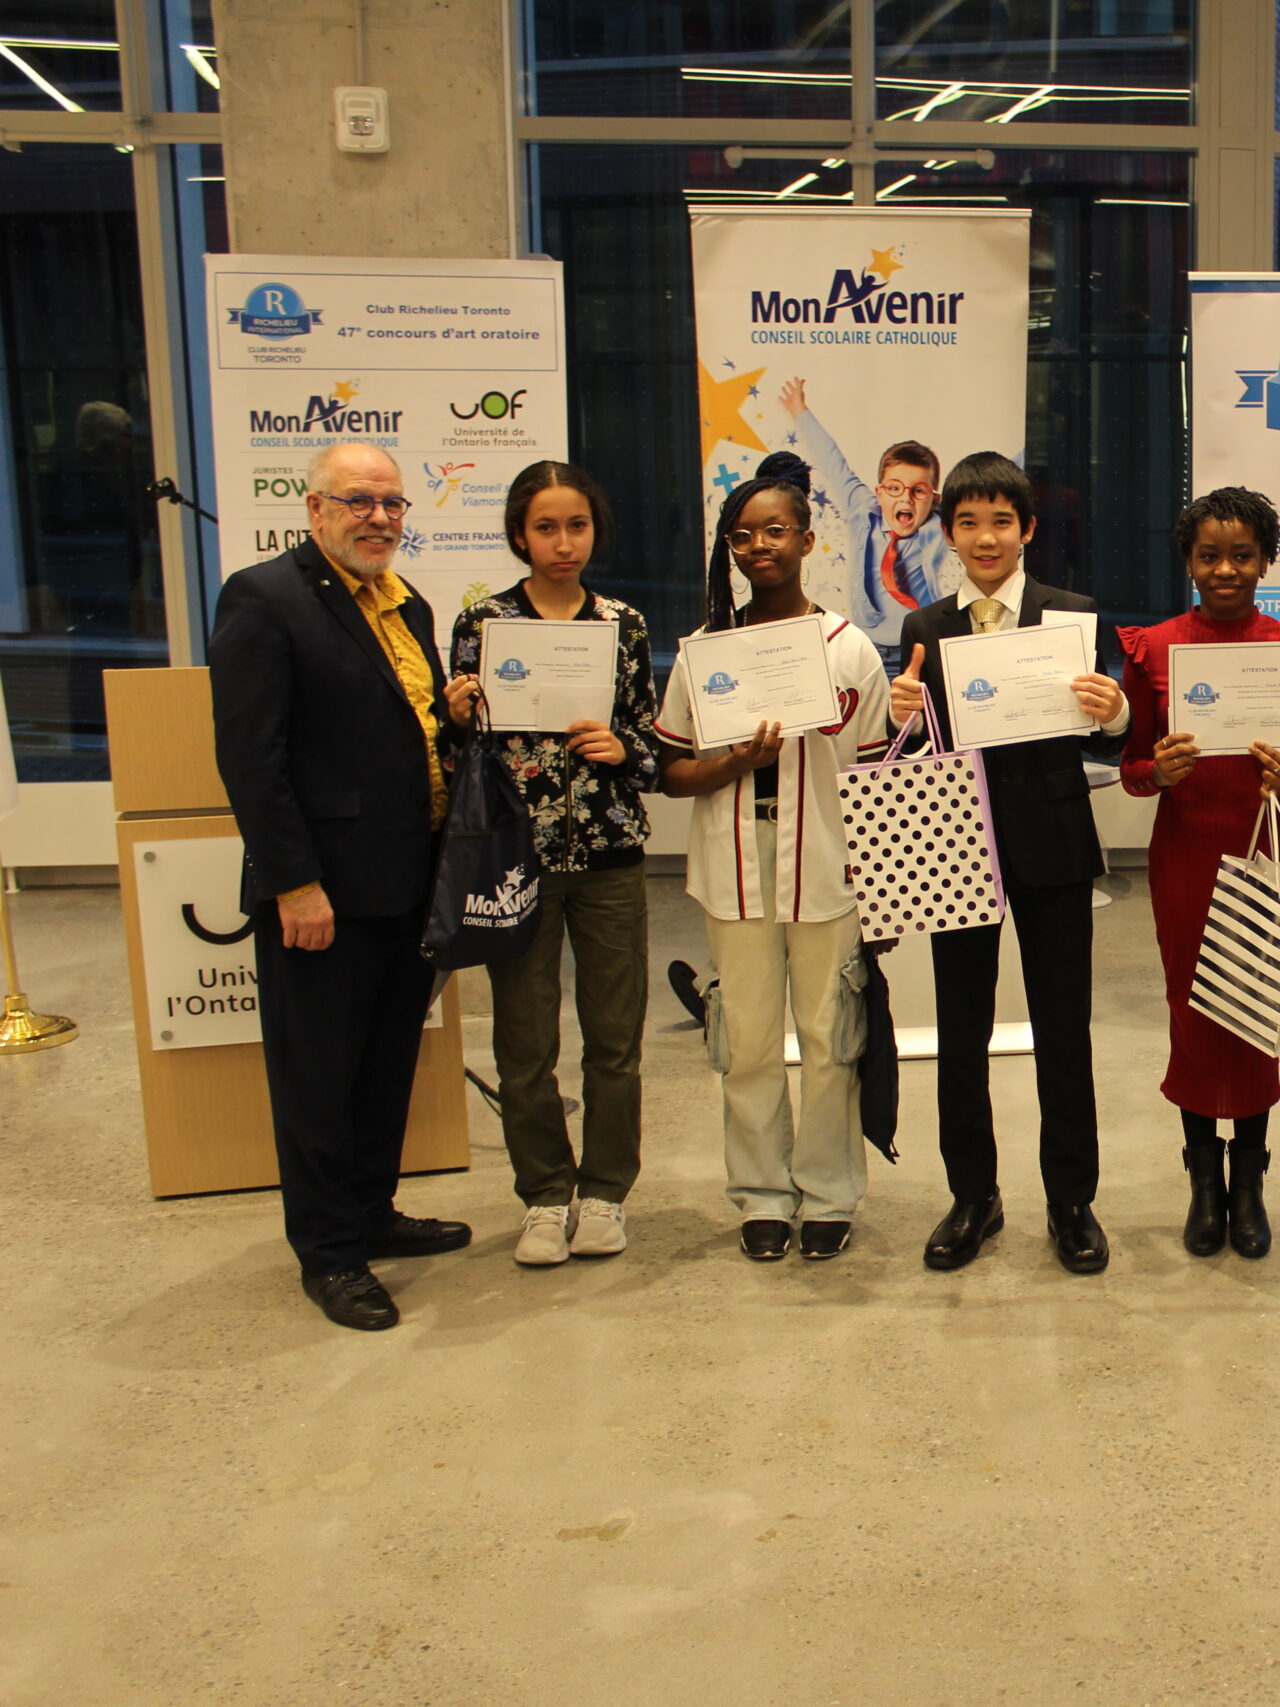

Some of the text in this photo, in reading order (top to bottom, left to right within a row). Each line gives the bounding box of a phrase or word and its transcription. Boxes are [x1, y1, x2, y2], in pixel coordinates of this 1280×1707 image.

[751, 268, 964, 324] MonAvenir
[264, 290, 287, 315] R
[366, 304, 511, 316] Club Richelieu Toronto
[367, 329, 437, 339] concours
[442, 328, 475, 339] d'art
[481, 329, 540, 340] oratoire
[751, 330, 957, 347] CONSEIL SCOLAIRE CATHOLIQUE
[254, 355, 301, 364] TORONTO
[250, 395, 403, 433] MonAvenir
[454, 427, 525, 437] Université de
[251, 437, 290, 447] CONSEIL
[493, 437, 537, 448] français
[462, 483, 502, 493] Conseil
[256, 529, 279, 552] LA
[432, 533, 470, 541] CENTRE
[462, 916, 493, 928] CONSEIL
